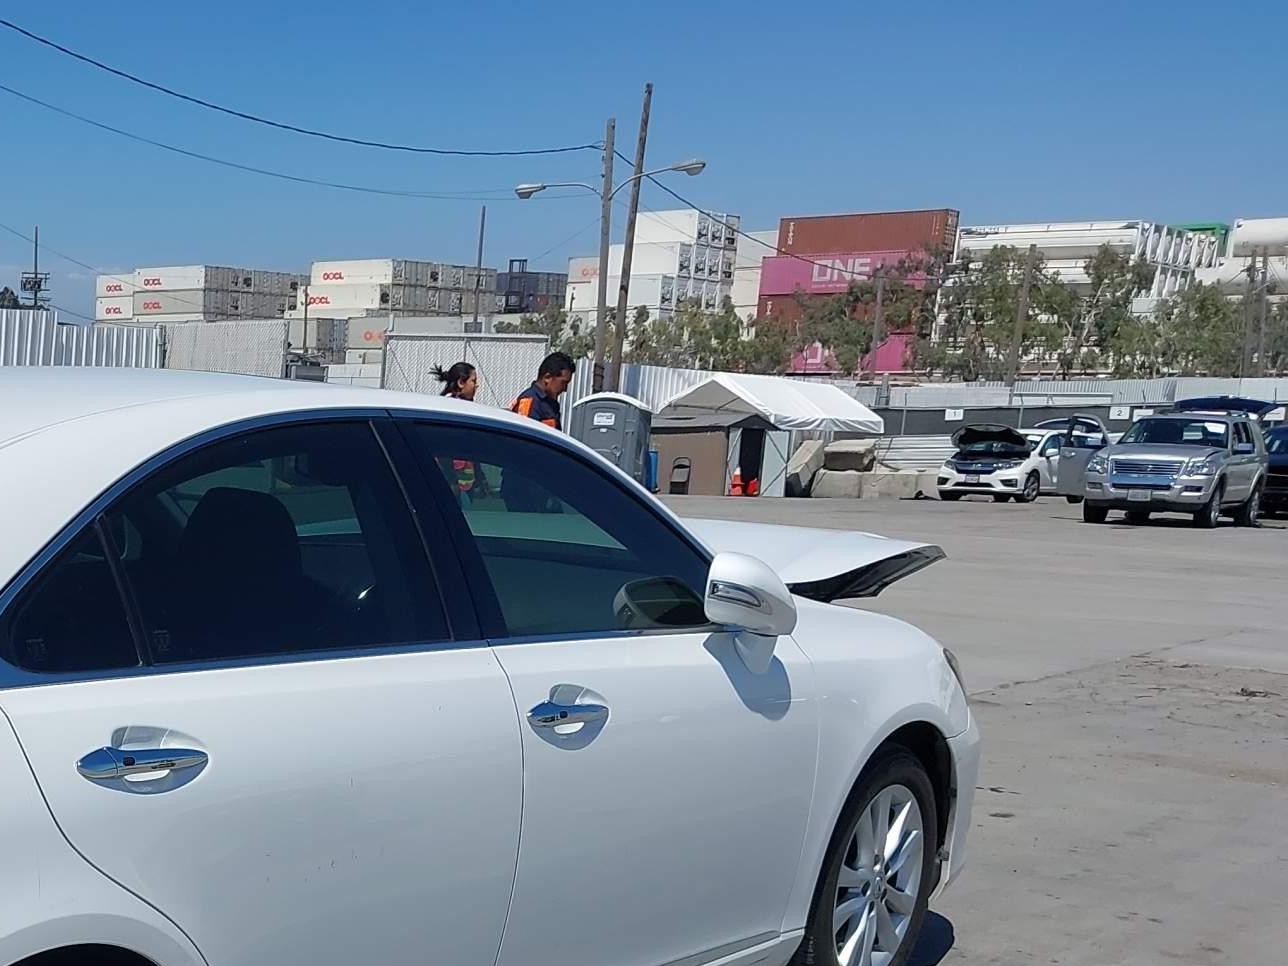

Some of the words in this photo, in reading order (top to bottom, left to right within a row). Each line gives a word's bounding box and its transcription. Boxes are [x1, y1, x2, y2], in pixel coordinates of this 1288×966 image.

[812, 258, 871, 282] ONE
[323, 271, 344, 281] OOCL
[144, 277, 162, 287] OOCL
[309, 296, 330, 304] OOCL
